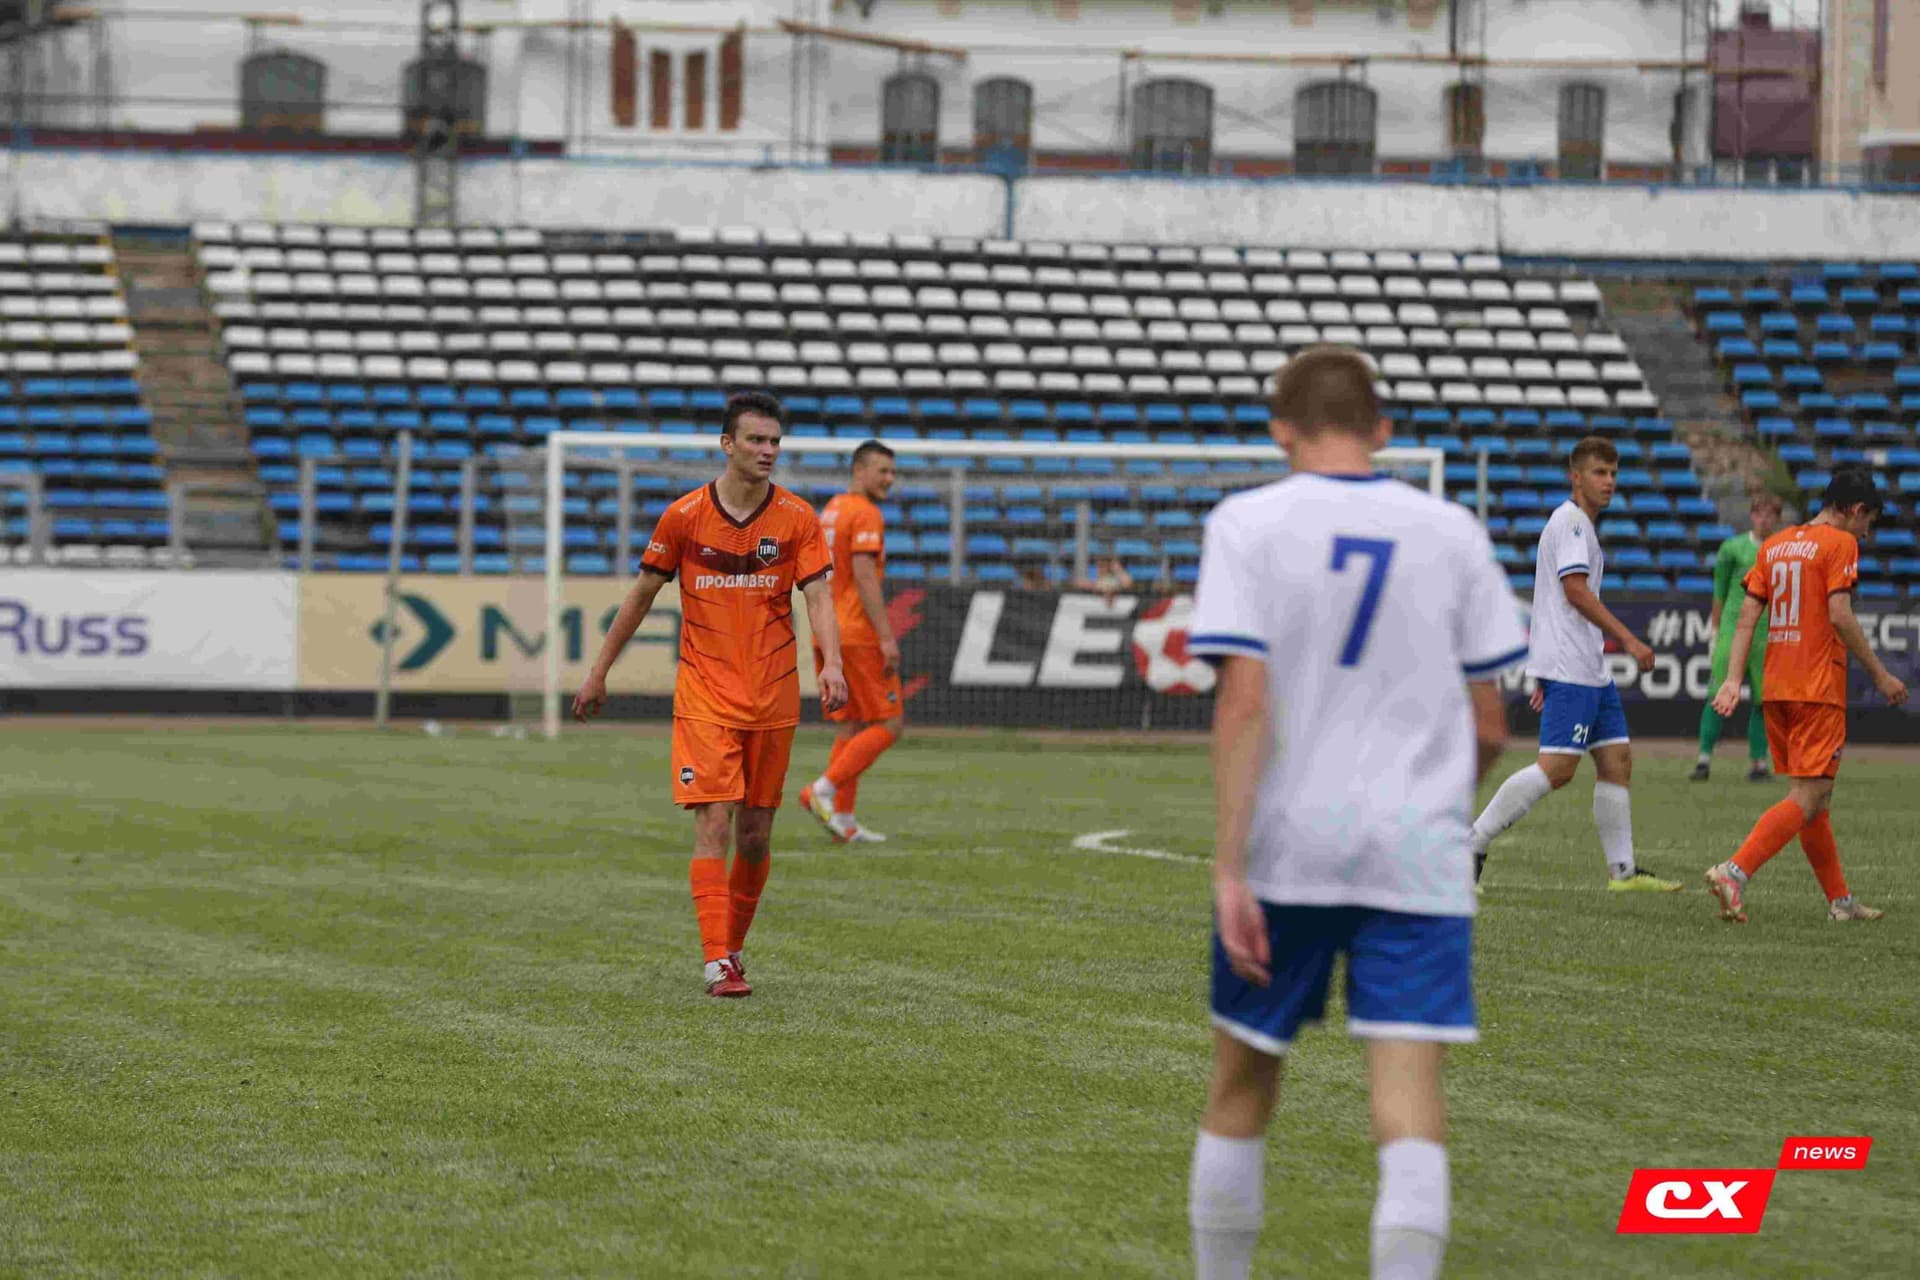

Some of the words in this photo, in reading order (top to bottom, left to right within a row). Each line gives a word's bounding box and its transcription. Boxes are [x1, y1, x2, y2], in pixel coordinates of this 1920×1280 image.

[1329, 536, 1396, 667] 7
[1769, 561, 1802, 627] 21
[1571, 723, 1590, 744] 21
